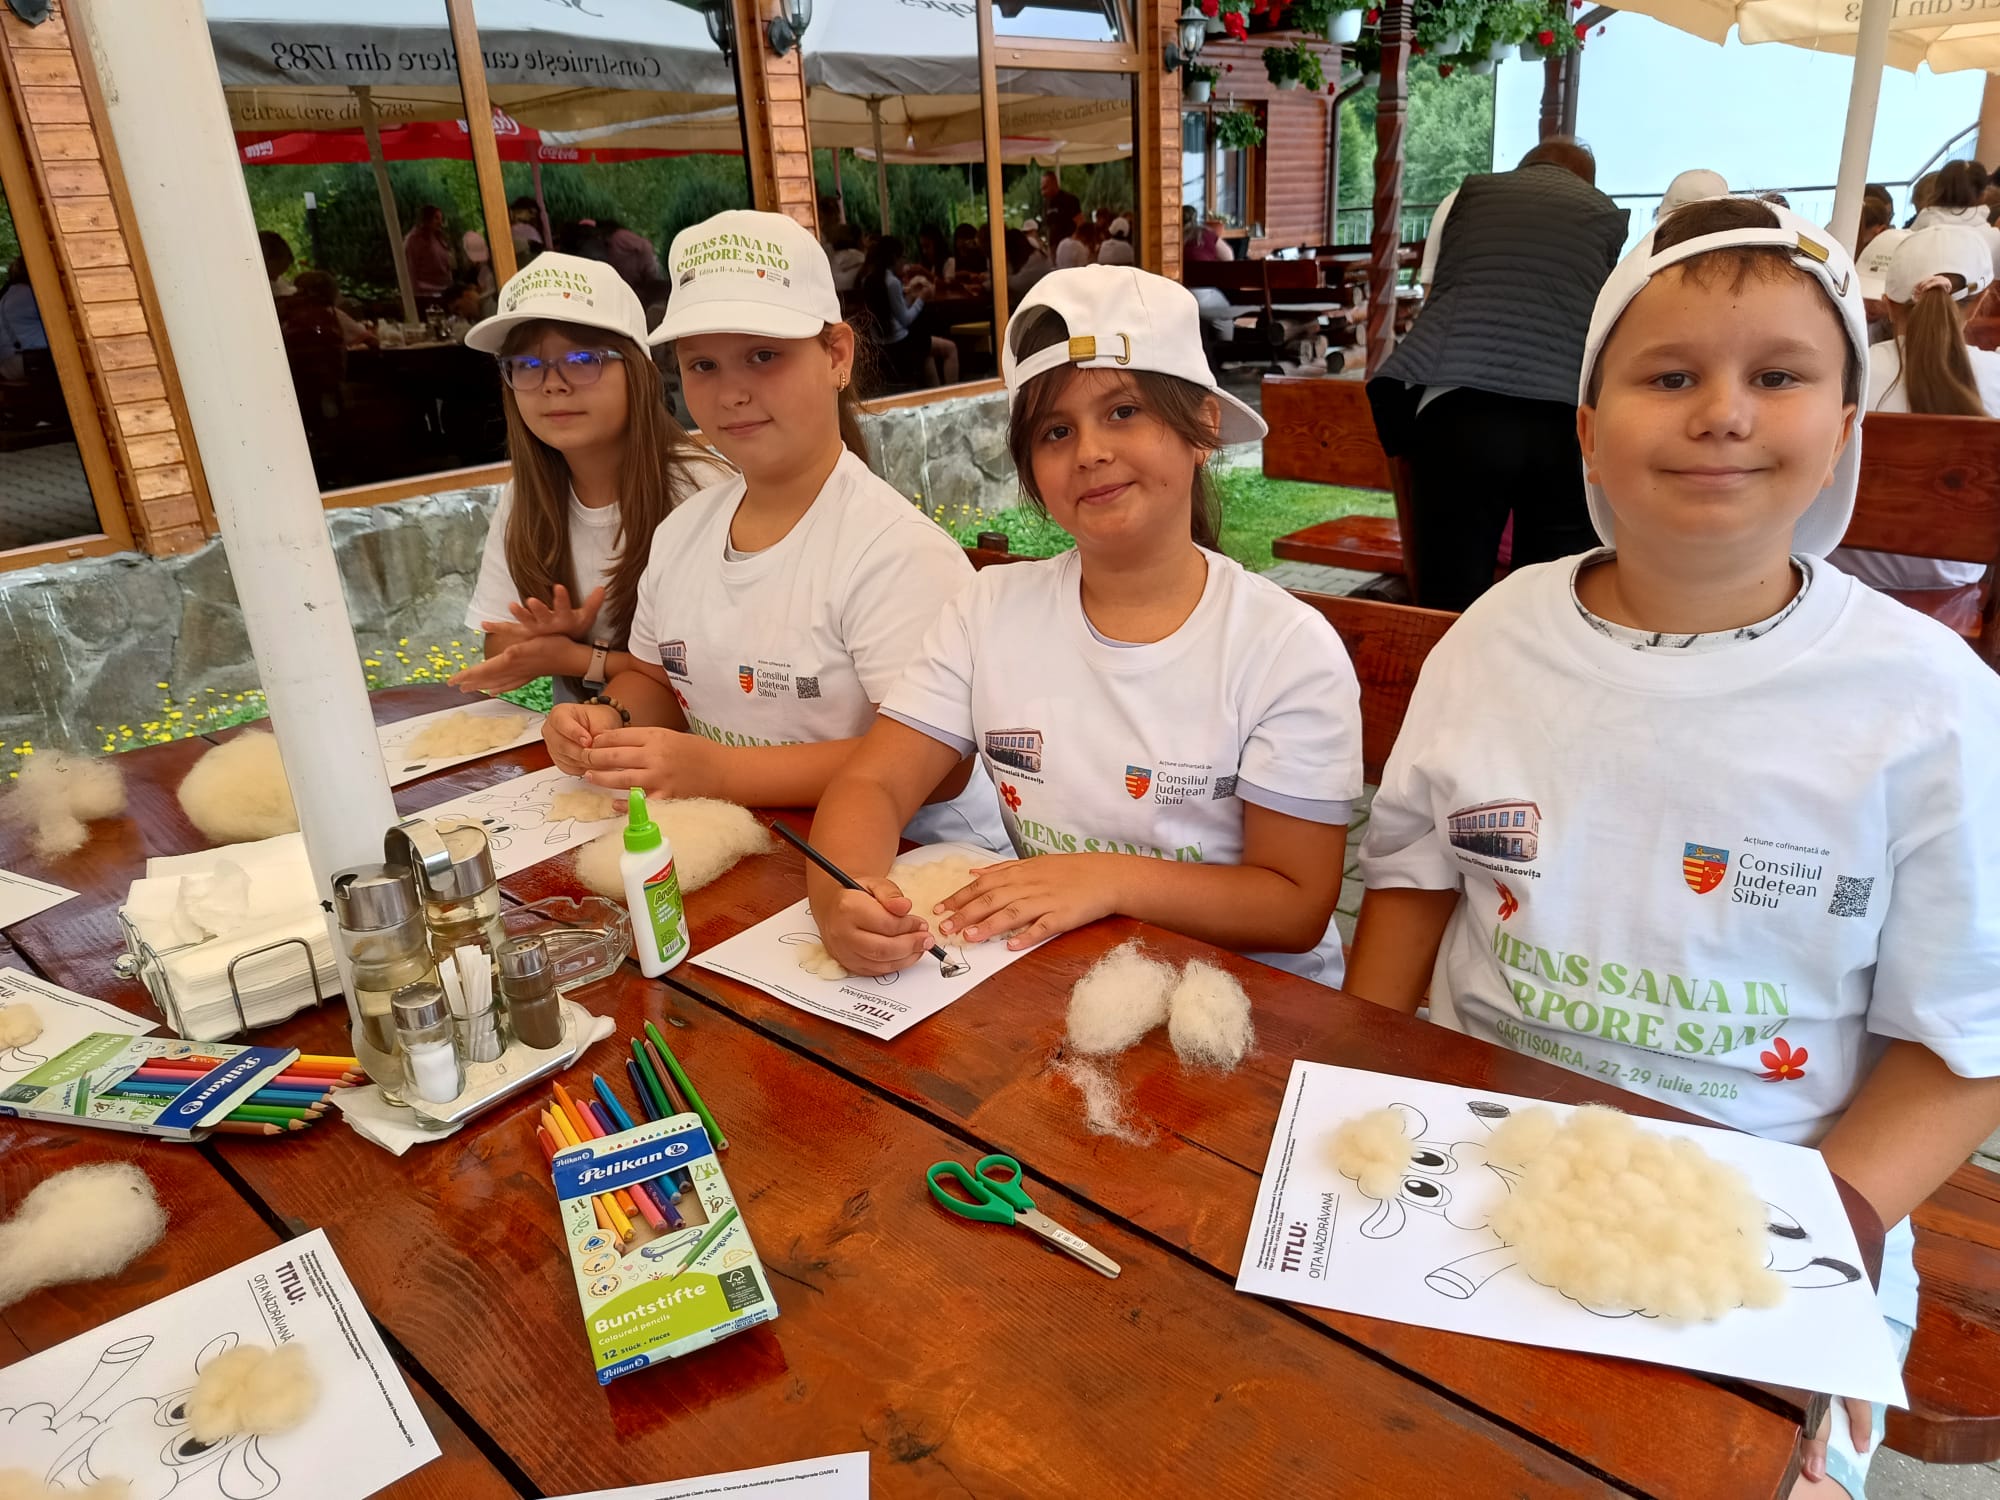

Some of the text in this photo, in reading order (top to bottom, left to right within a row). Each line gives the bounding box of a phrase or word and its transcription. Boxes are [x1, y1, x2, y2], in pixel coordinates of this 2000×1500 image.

[719, 233, 762, 252] SANA
[766, 241, 783, 256] IN
[676, 248, 790, 273] CORPORE SANO
[533, 268, 570, 281] SANA
[574, 272, 589, 284] IN
[553, 279, 593, 295] SANO
[756, 668, 790, 682] Consiliul
[757, 687, 778, 698] Sibiu
[1157, 771, 1209, 785] Consiliul
[1153, 793, 1183, 805] Sibiu
[1014, 813, 1077, 853] MENS
[1175, 841, 1203, 862] IN
[1820, 848, 1831, 857] de
[1504, 865, 1542, 880] Racovița
[1738, 853, 1823, 881] Consiliul
[1734, 870, 1818, 898] Județean
[1731, 887, 1780, 909] Sibiu
[1490, 922, 1790, 1017] MENS SANA IN
[852, 1002, 896, 1022] TITLU:
[1512, 978, 1665, 1050] RPORE
[197, 1055, 262, 1101] Pelikan
[1597, 1059, 1652, 1085] 27-29
[1656, 1073, 1694, 1095] iulie
[1698, 1081, 1739, 1101] 2026
[555, 1156, 582, 1168] Pelikan
[577, 1150, 664, 1186] Pelikan
[701, 1231, 734, 1262] Triangular
[1280, 1221, 1308, 1273] TITLU:
[275, 1260, 307, 1306] TITLU:
[594, 1284, 707, 1334] Buntstifte
[598, 1314, 671, 1346] Coloured pencils
[602, 1349, 618, 1361] 12
[648, 1331, 671, 1344] Pieces
[603, 1362, 635, 1379] Pelikan
